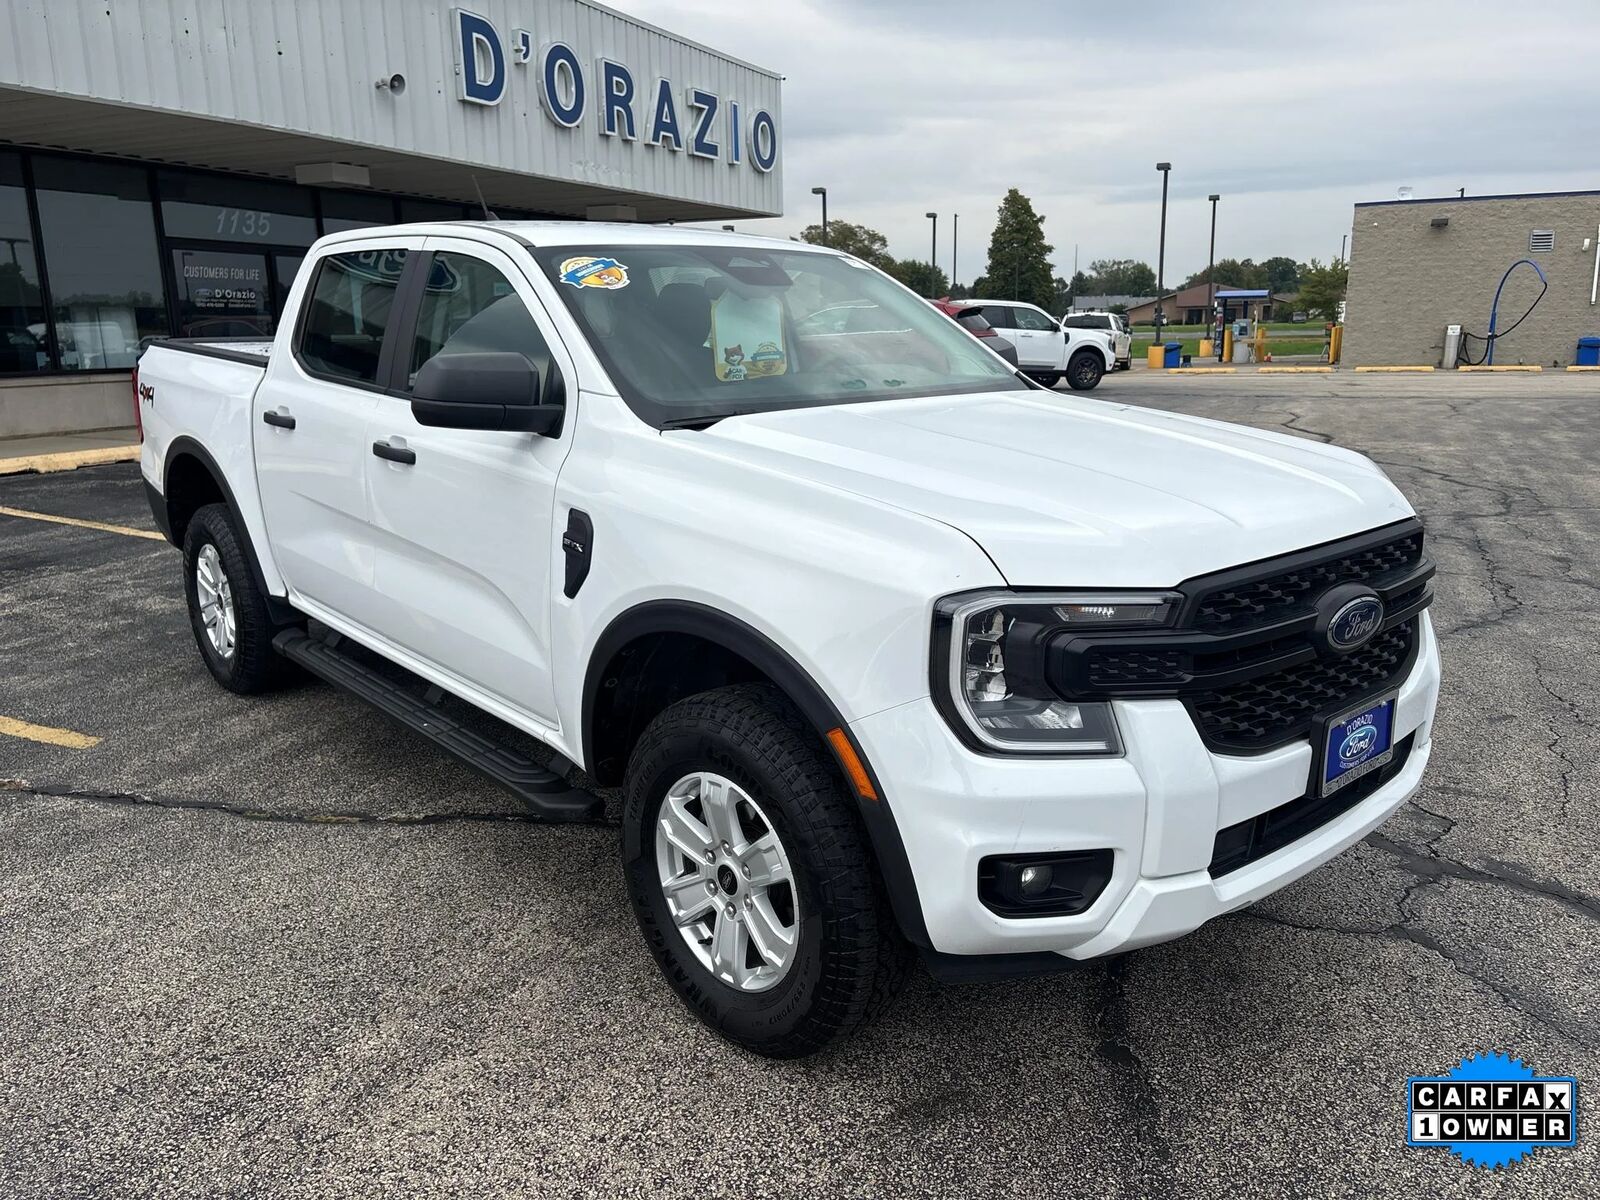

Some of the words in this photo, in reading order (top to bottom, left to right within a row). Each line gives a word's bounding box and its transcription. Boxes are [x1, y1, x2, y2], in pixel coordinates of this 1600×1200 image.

[453, 8, 777, 173] D'ORAZIO
[217, 209, 271, 236] 1135
[184, 265, 229, 279] CUSTOMERS
[231, 269, 244, 280] FOR
[246, 271, 260, 281] LIFE
[215, 289, 256, 299] D'Orazio
[1345, 608, 1375, 640] Ford
[1347, 714, 1373, 735] D'ORAZIO
[1346, 731, 1371, 757] Ford
